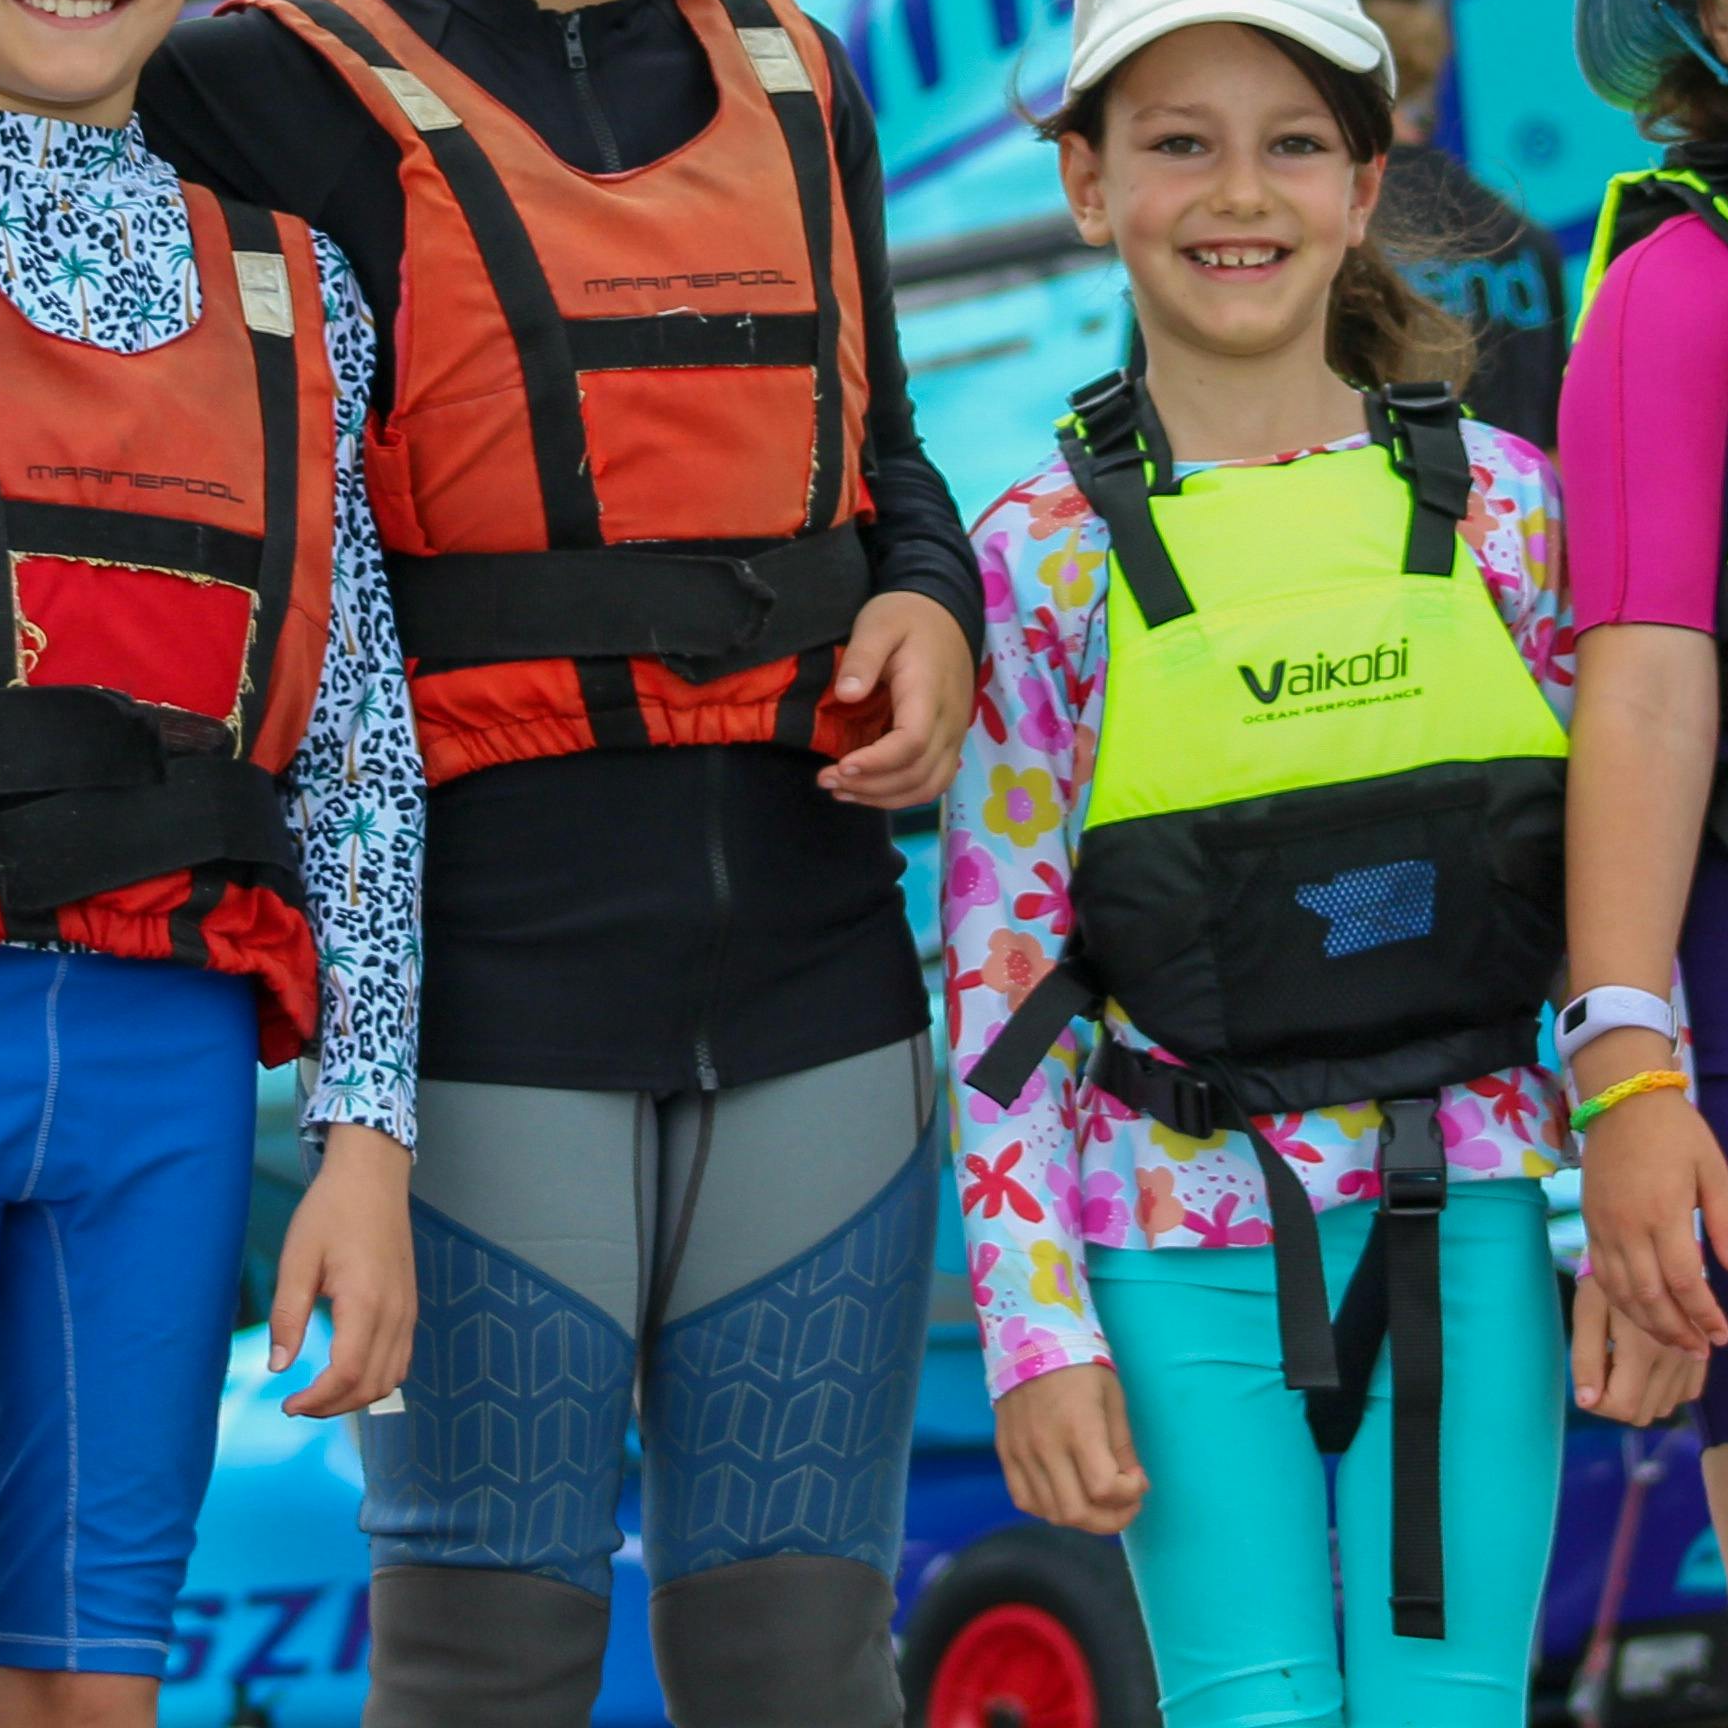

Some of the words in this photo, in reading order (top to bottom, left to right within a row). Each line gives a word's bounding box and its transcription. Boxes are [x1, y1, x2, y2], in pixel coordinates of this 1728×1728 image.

[583, 270, 797, 295] MARINEPOOL
[27, 465, 245, 504] MARINEPOOL
[1237, 637, 1408, 704] Vaikobi
[1242, 709, 1300, 724] OCEAN
[1304, 687, 1423, 715] PERFORMANCE
